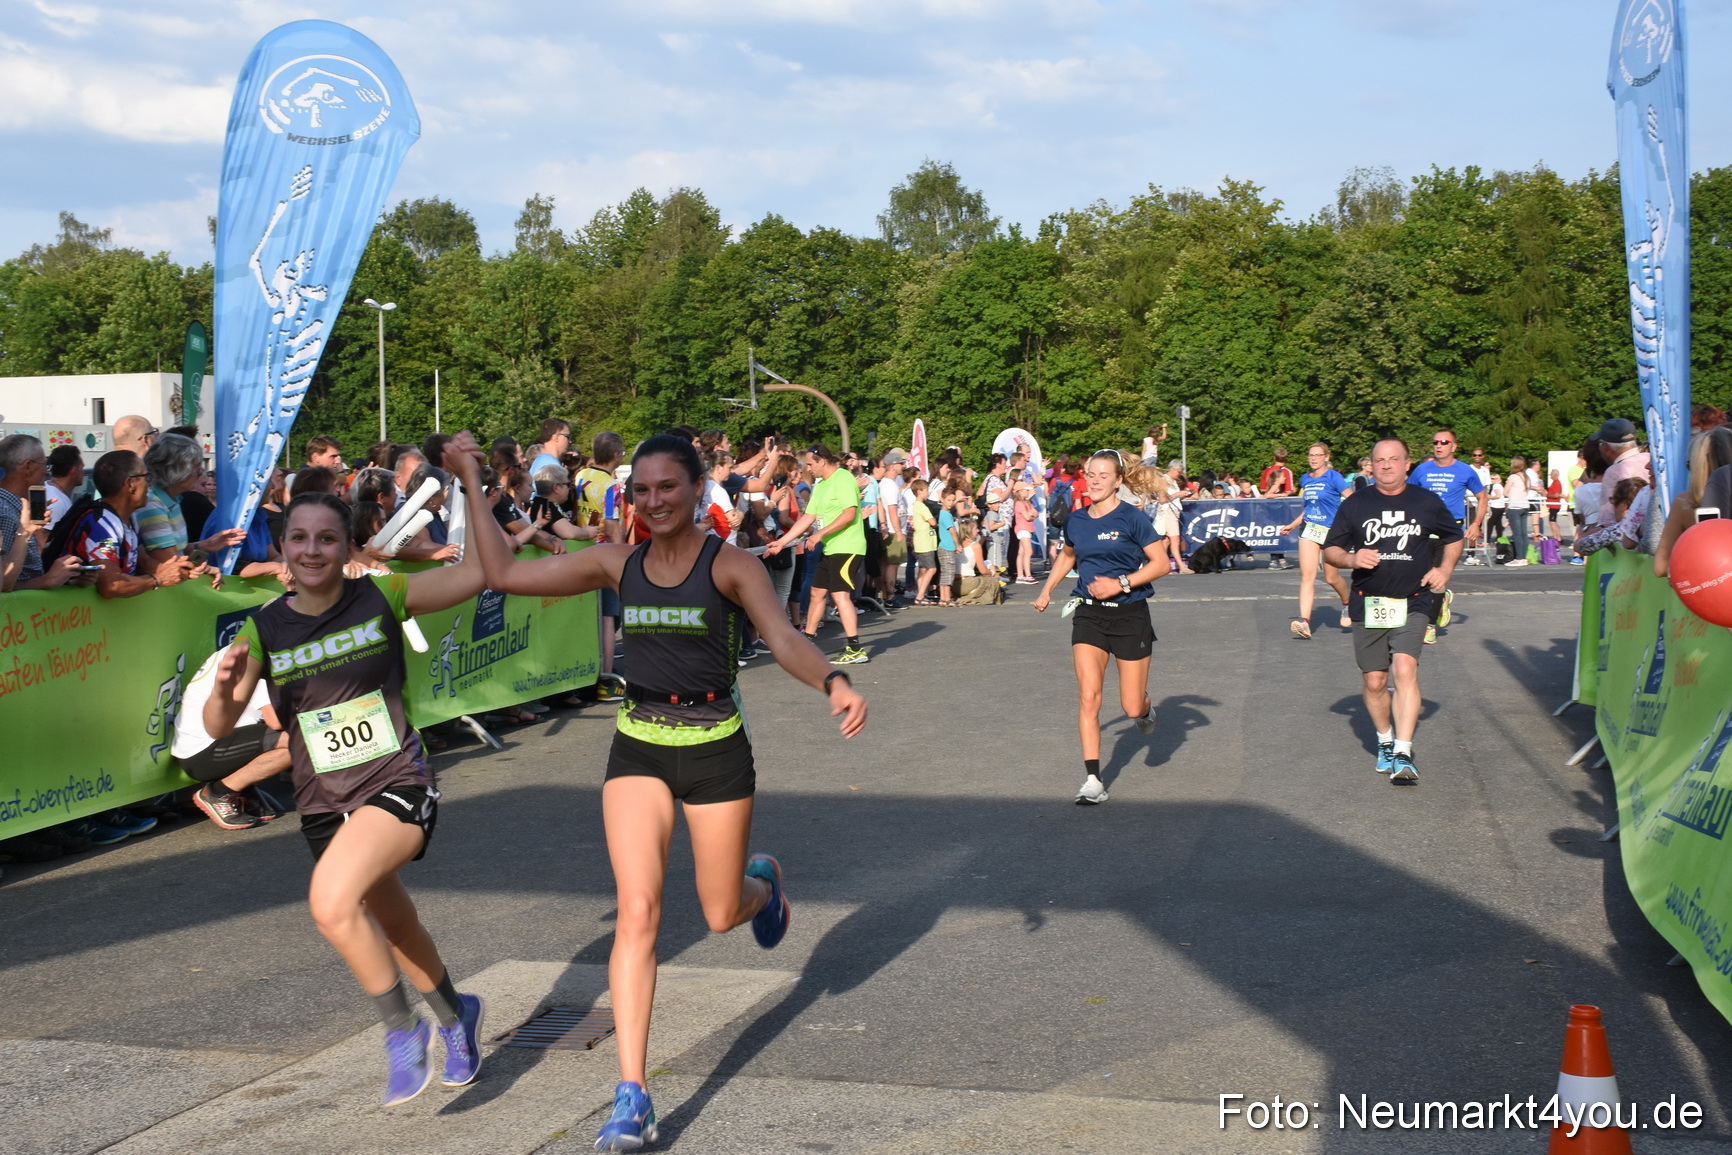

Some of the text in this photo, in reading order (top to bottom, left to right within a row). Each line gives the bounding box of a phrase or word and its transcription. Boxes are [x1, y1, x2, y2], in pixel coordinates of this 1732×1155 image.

[286, 107, 391, 146] WECHSELSZENE
[1205, 522, 1286, 539] Fischer
[1307, 528, 1322, 539] 733
[1362, 518, 1421, 551] Burgis
[1376, 552, 1414, 561] ödelliebe.
[0, 605, 93, 649] de Firmen
[624, 607, 707, 628] BOCK
[677, 628, 709, 636] concepts
[47, 627, 110, 682] länger!
[269, 617, 386, 676] BOCK
[457, 613, 532, 676] firmenlauf
[305, 667, 318, 679] by
[320, 655, 351, 672] smart
[459, 668, 494, 692] neumarkt
[324, 720, 374, 752] 300
[329, 741, 379, 760] Hecker Daniela
